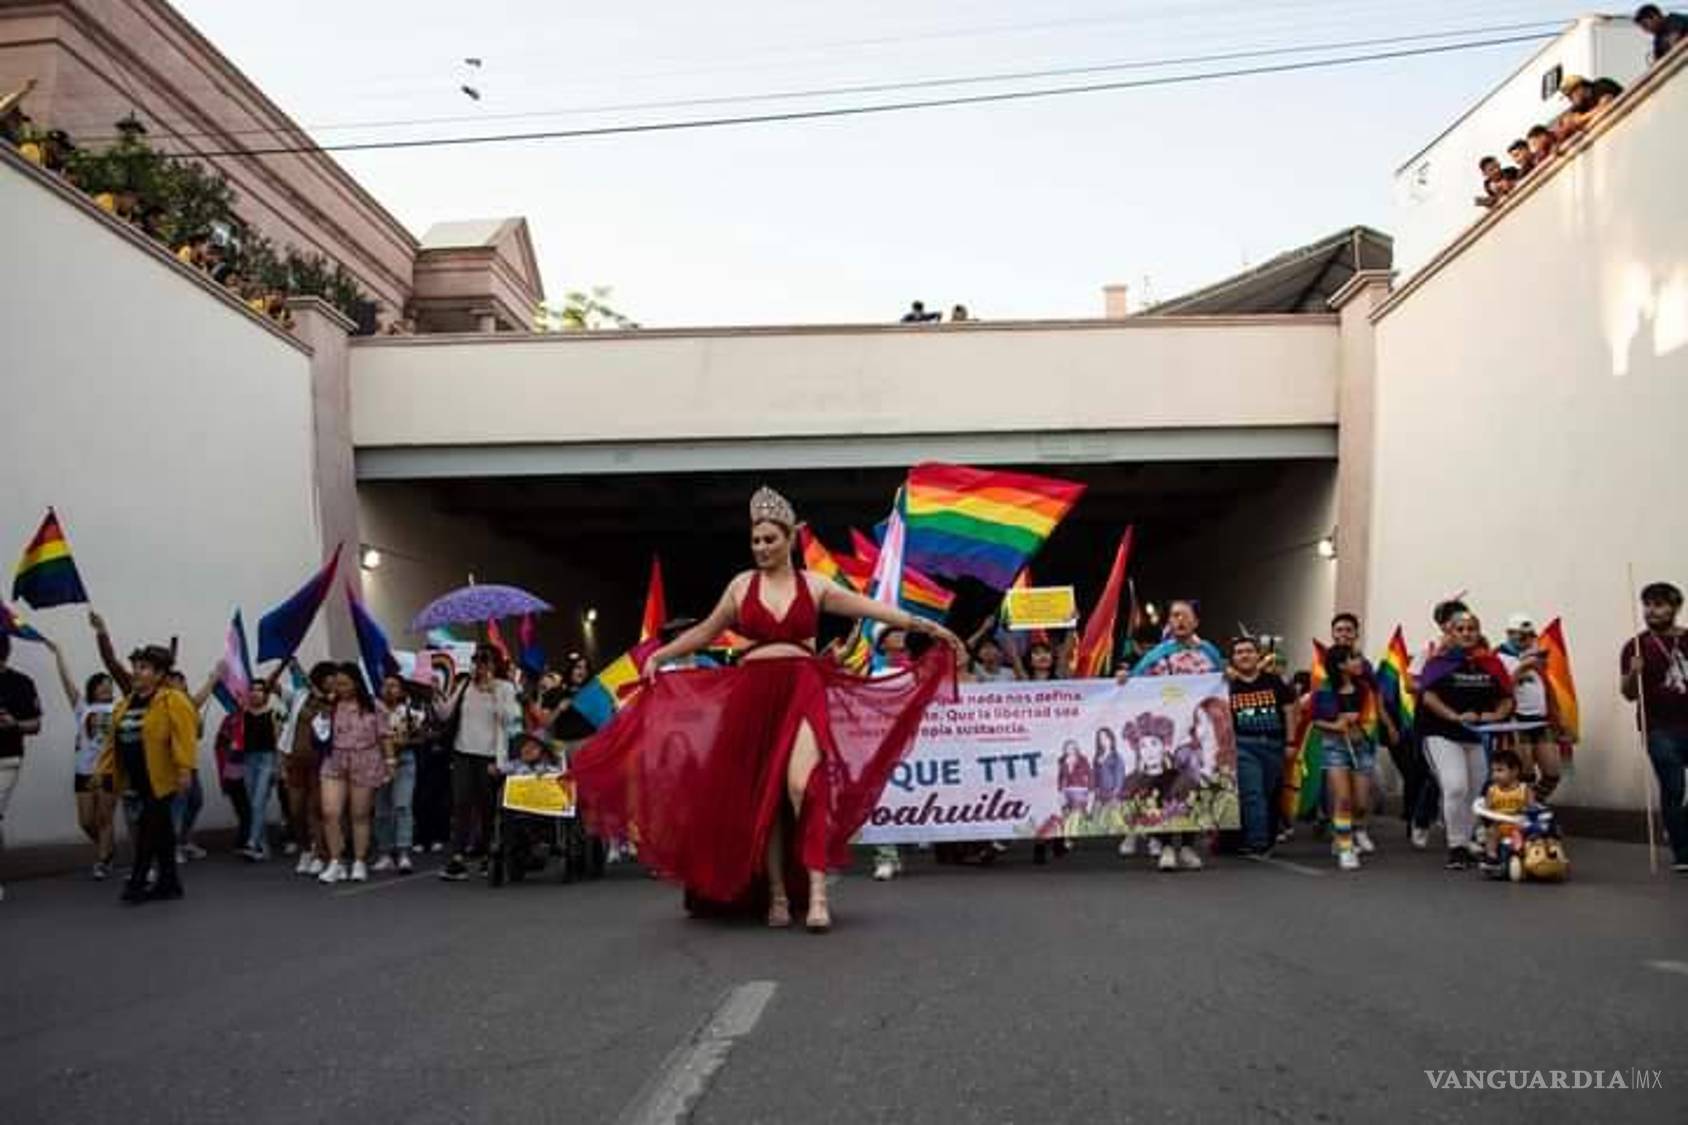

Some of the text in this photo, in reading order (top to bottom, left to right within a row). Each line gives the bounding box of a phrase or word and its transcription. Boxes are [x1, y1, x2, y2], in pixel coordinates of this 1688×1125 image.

[967, 690, 1002, 704] nada
[1006, 692, 1032, 704] nos
[947, 708, 975, 722] Que
[978, 707, 991, 720] la
[994, 705, 1051, 719] libertad
[1054, 705, 1080, 717] sea
[920, 724, 953, 737] opia
[889, 751, 1043, 791] QUE TTT
[870, 787, 1033, 827] oahuila
